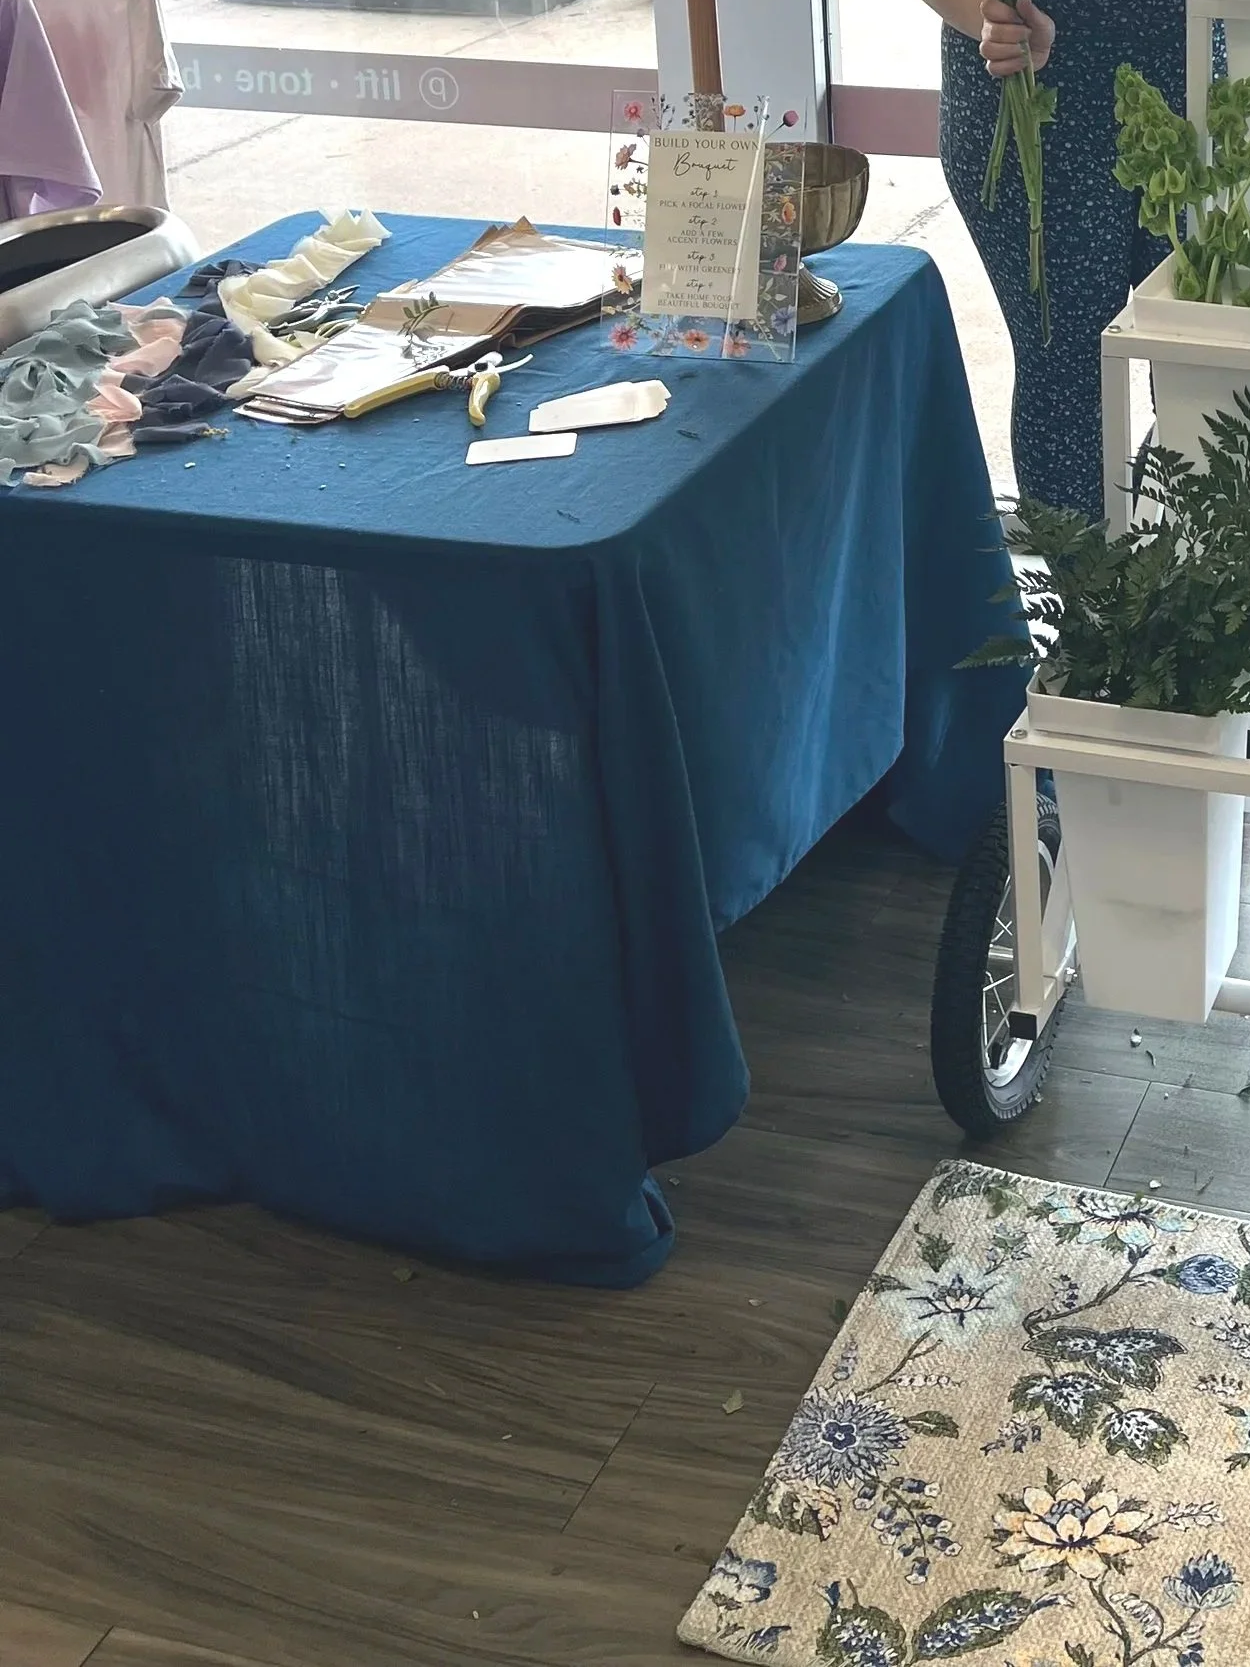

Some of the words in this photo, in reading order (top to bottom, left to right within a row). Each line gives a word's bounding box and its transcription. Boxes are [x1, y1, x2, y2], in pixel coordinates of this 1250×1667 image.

[654, 137, 689, 148] BUILD
[695, 139, 726, 150] YOUR
[731, 140, 760, 151] OWN
[673, 151, 739, 181] Bouquet
[690, 187, 710, 200] step
[659, 200, 677, 208] PICK
[689, 201, 714, 210] FOCAL
[688, 215, 708, 230] step
[711, 217, 718, 226] 2
[707, 230, 724, 238] FEW
[667, 236, 698, 244] ACCENT
[701, 237, 738, 246] FLOWERS
[687, 251, 707, 264] step
[678, 264, 699, 272] WITH
